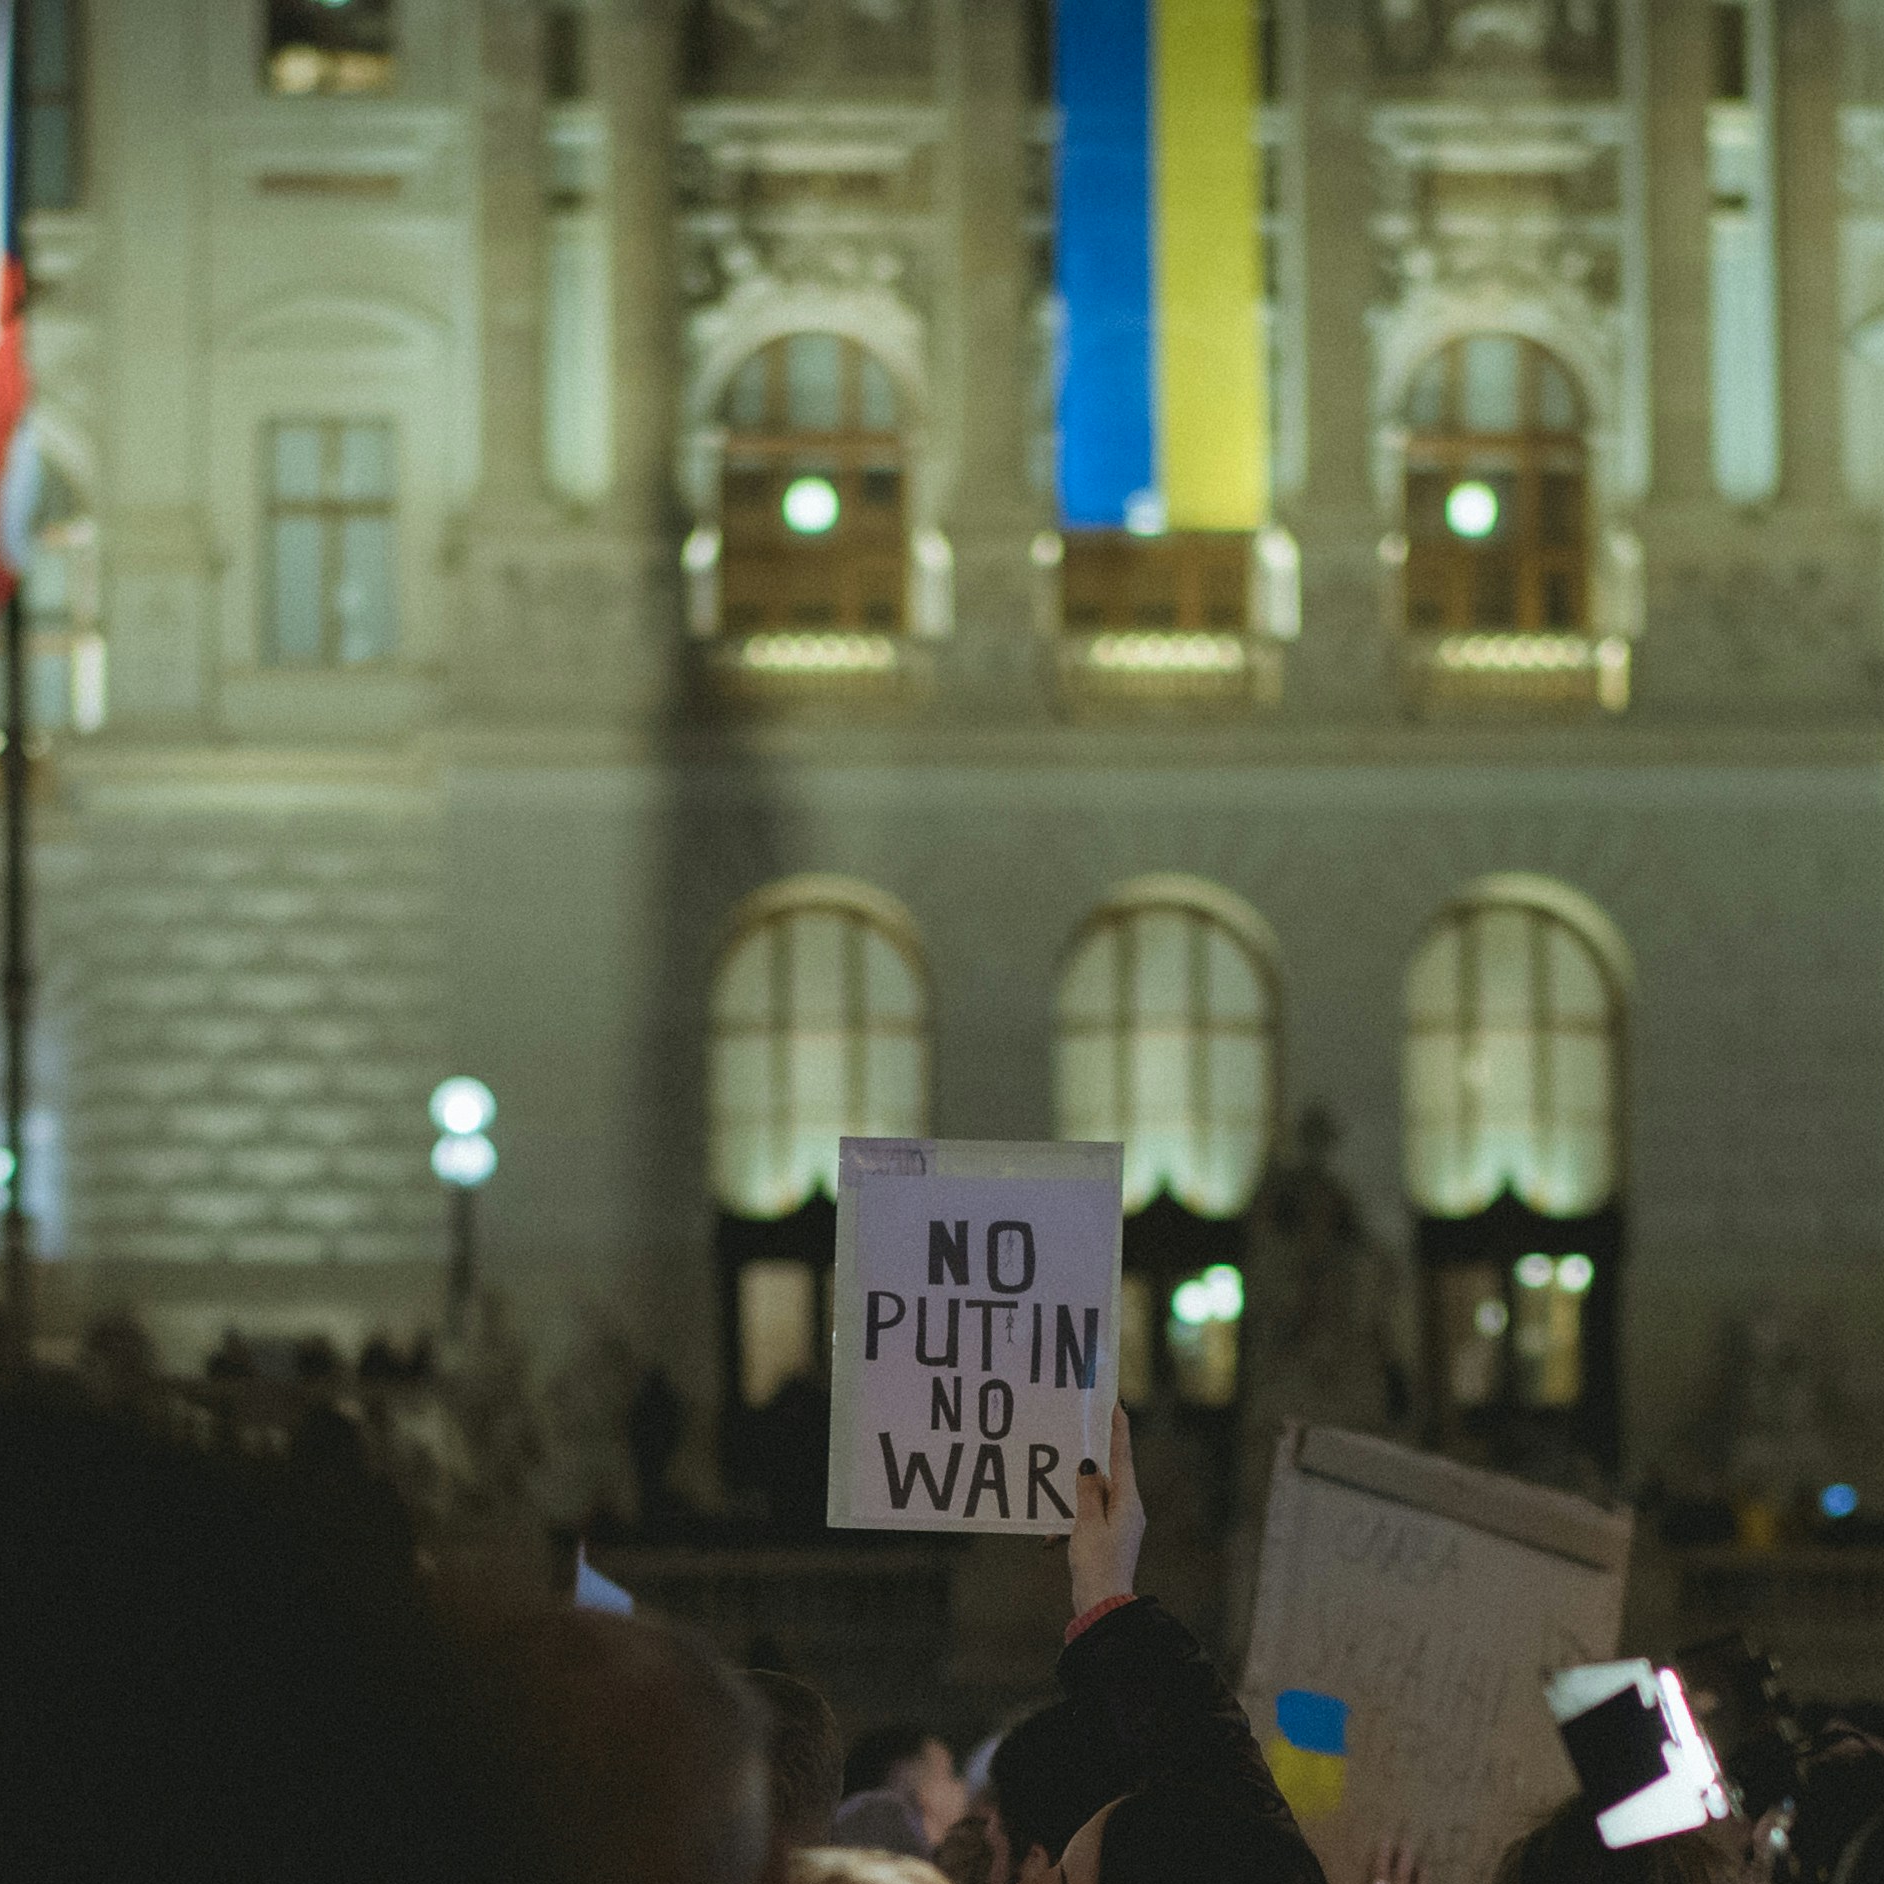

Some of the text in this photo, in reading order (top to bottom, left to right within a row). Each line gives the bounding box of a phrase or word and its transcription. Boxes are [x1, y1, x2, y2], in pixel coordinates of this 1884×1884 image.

[928, 1220, 1036, 1294] NO
[864, 1290, 1099, 1389] PUTIN
[930, 1376, 1014, 1440] NO
[878, 1431, 1076, 1520] WAR
